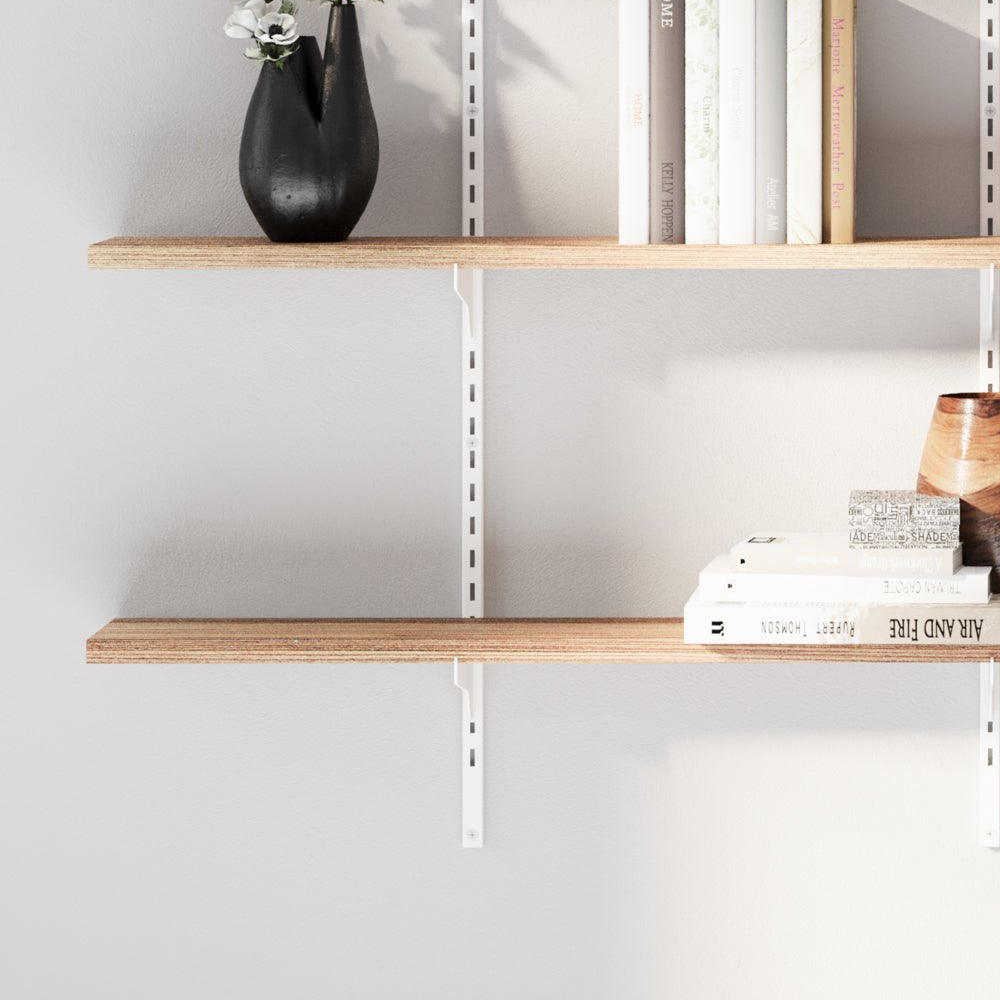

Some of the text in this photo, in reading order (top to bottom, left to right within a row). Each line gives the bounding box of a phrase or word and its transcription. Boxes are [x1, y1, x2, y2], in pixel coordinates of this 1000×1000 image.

[829, 18, 844, 75] Marjorie
[634, 94, 642, 126] HOME
[662, 163, 673, 242] KELLY HOPPEN
[768, 176, 779, 231] Atelier AM
[832, 183, 844, 209] Post
[883, 580, 922, 594] CAPOTE
[761, 621, 855, 637] RUPERT THOMSON
[889, 618, 984, 641] AIR AND FIRE
